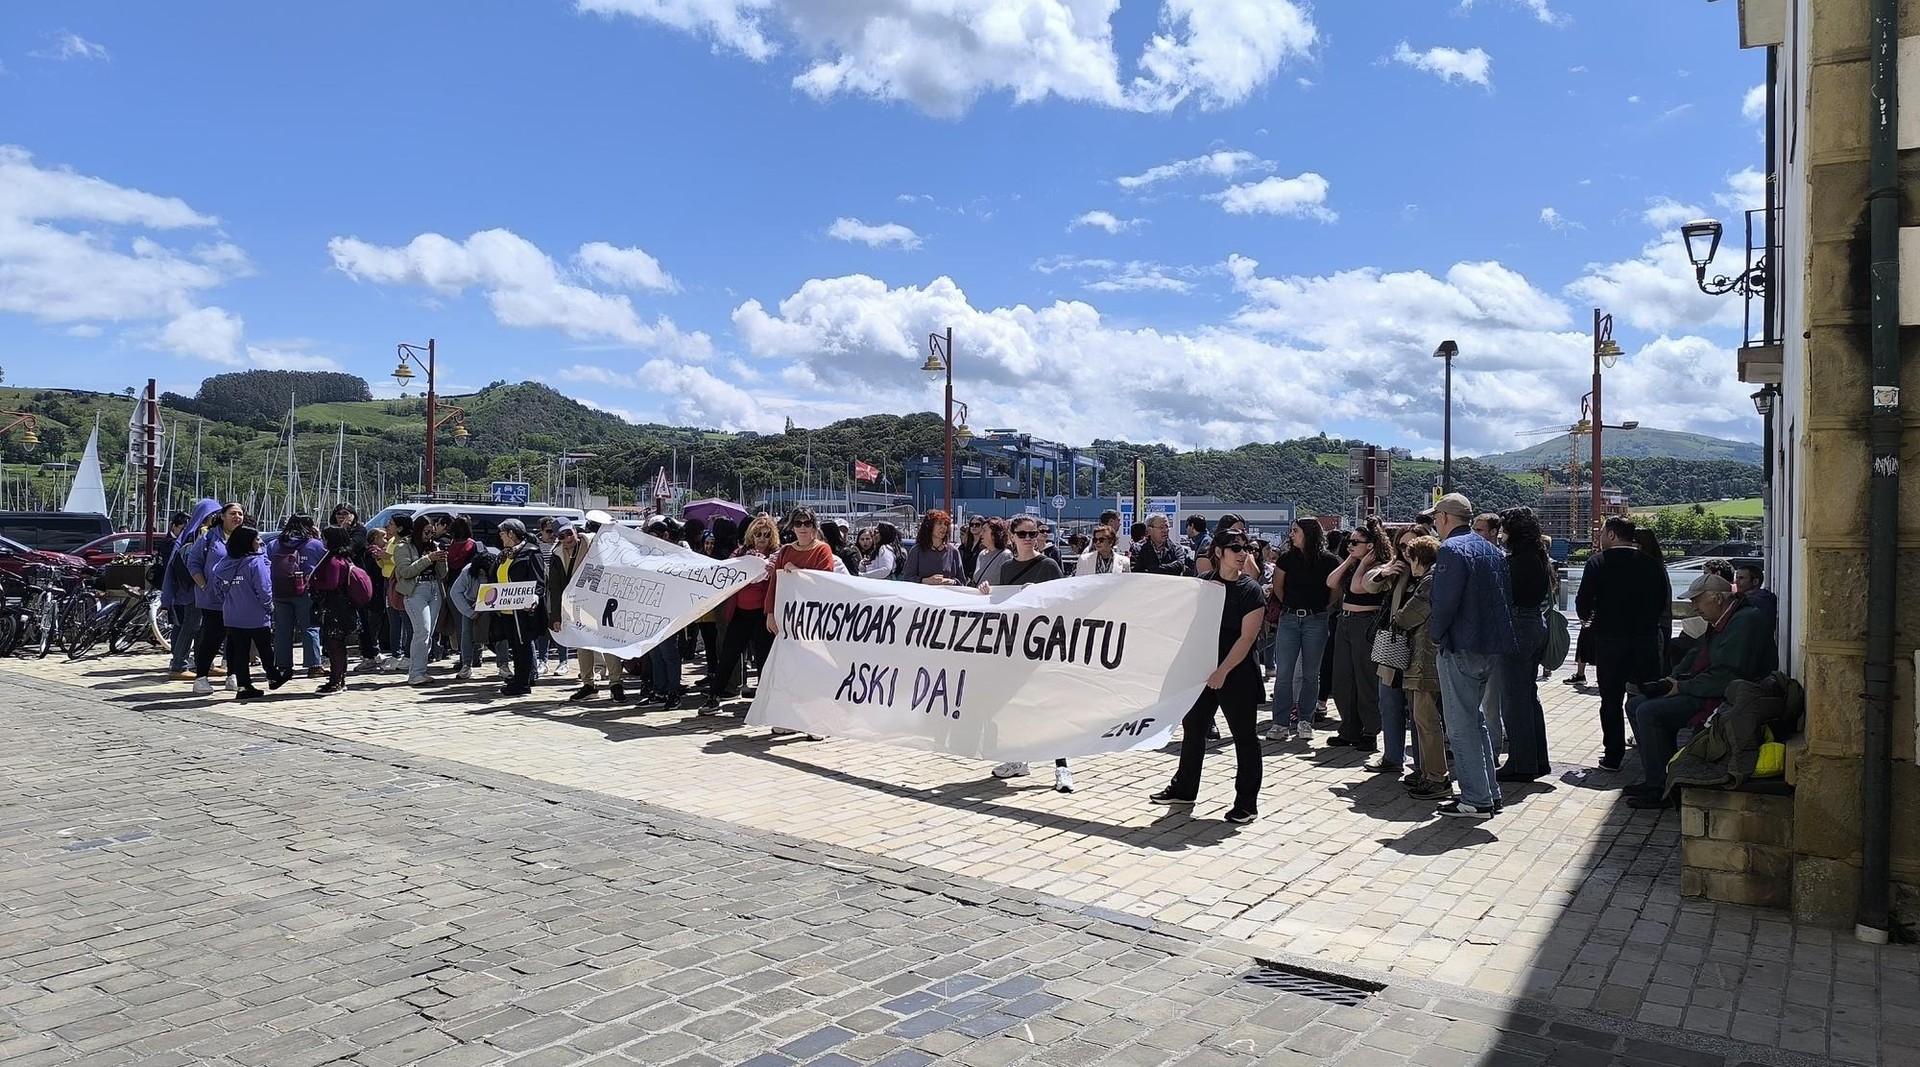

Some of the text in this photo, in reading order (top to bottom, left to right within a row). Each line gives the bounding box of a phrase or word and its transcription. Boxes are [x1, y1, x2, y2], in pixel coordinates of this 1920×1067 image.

[499, 598, 511, 606] CON
[501, 587, 535, 597] MUJERES
[783, 601, 1127, 670] MATXISMOAK HILTZEN GAITU
[835, 662, 966, 720] ASKI DA!
